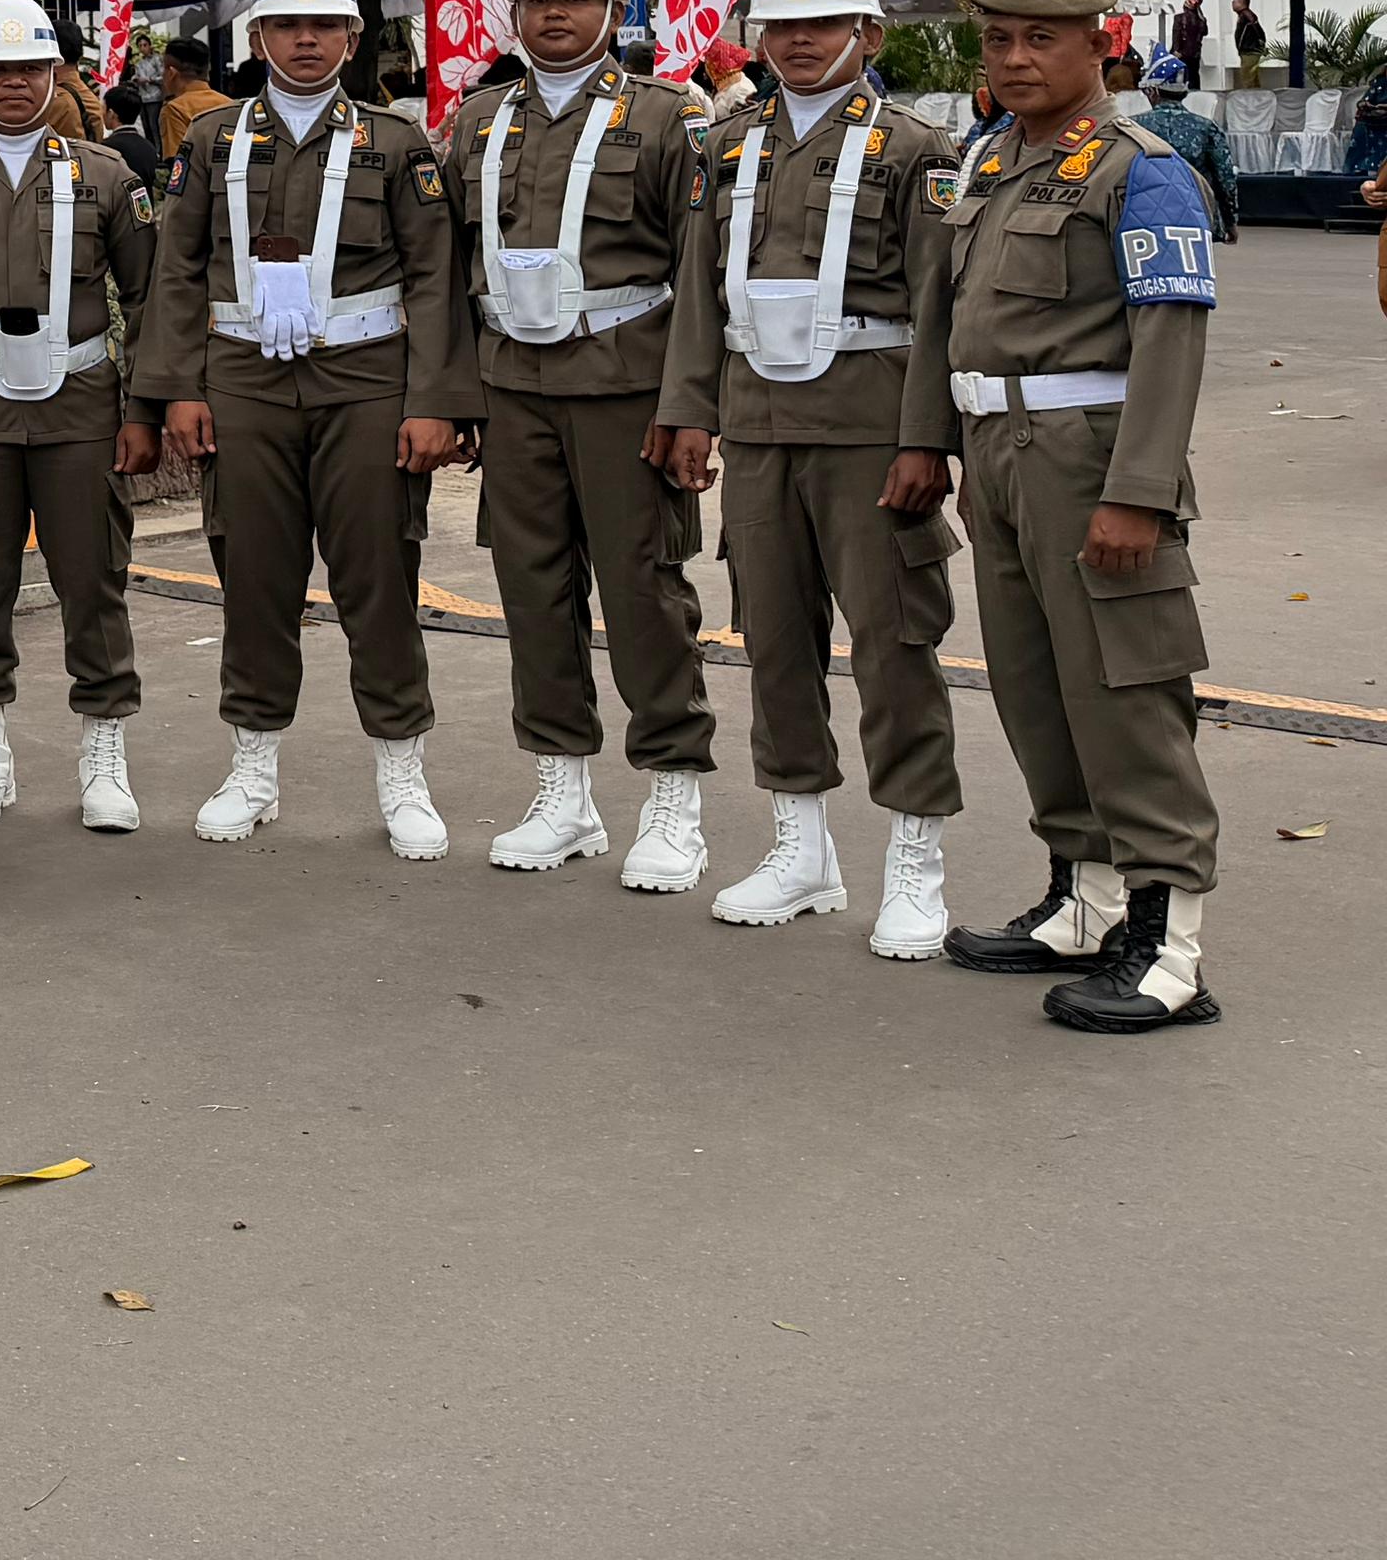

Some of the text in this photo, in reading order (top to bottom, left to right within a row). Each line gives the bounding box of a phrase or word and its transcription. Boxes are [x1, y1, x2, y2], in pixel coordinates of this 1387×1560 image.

[618, 30, 635, 40] VIP
[361, 155, 382, 165] PP
[1027, 186, 1083, 201] POL PP
